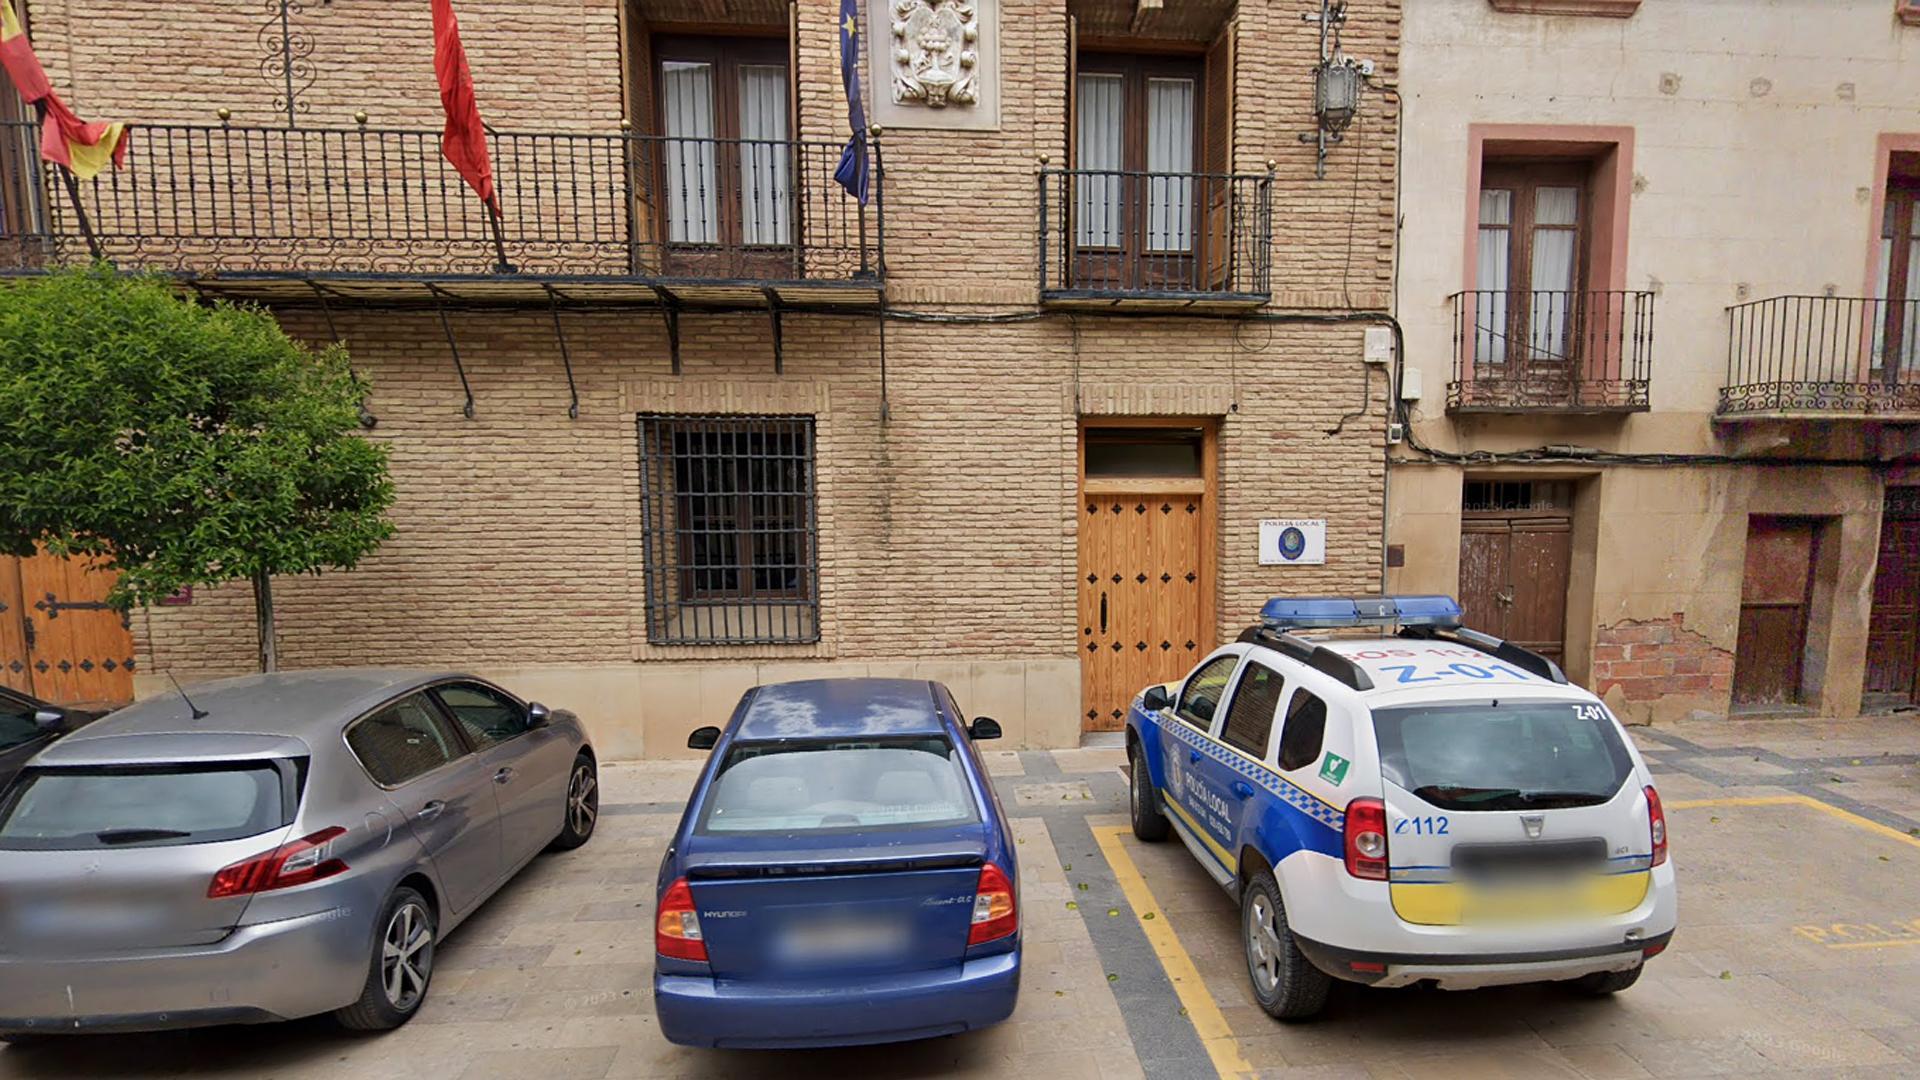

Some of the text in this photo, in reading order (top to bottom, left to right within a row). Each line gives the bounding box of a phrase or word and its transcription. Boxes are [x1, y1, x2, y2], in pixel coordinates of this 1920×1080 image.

[1378, 662, 1531, 684] Z-01
[1571, 704, 1608, 721] Z-01
[1207, 790, 1232, 824] LOCAL
[1411, 816, 1449, 835] 112
[703, 910, 748, 919] HYUNDAI
